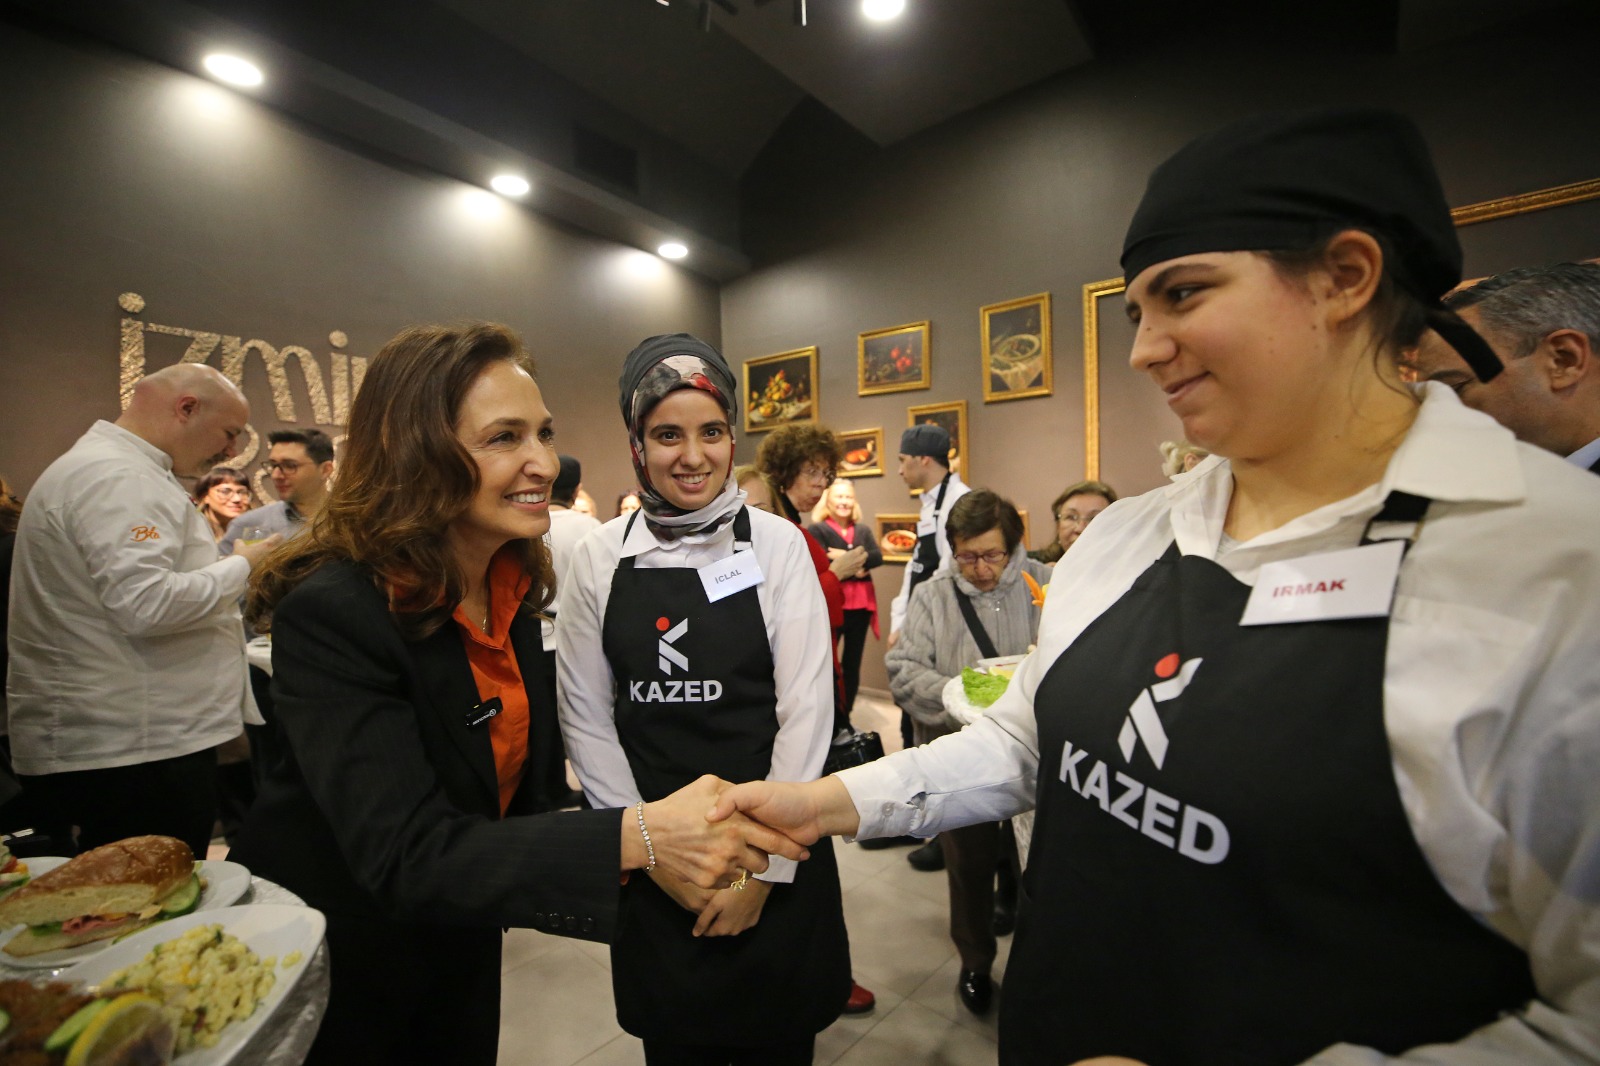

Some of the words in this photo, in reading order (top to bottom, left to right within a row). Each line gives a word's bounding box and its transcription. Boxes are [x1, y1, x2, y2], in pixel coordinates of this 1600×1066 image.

[1272, 579, 1346, 598] IRMAK
[630, 680, 723, 703] KAZED
[1059, 740, 1230, 865] KAZED
